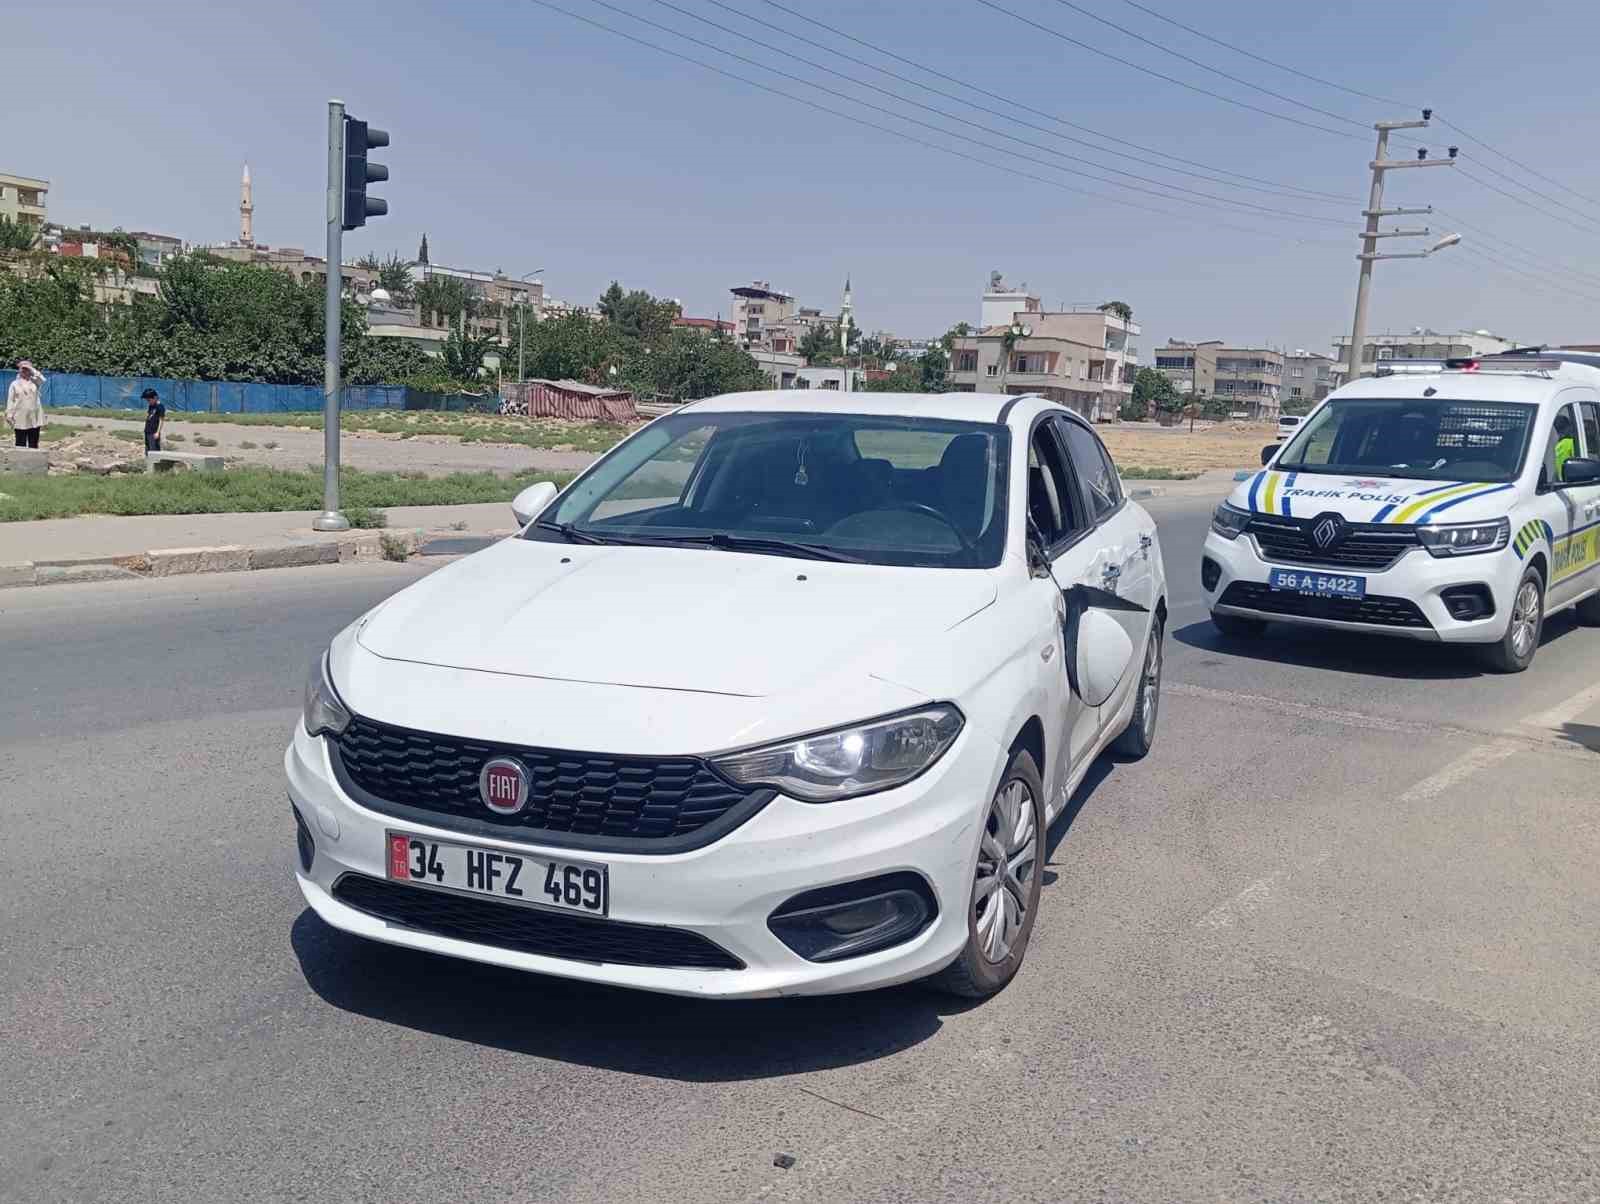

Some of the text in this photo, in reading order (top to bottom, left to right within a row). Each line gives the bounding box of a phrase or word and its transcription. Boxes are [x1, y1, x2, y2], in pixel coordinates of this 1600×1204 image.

[1278, 573, 1358, 593] 56 A 5422
[490, 774, 517, 800] FIAT
[409, 840, 601, 910] 34 HFZ 469
